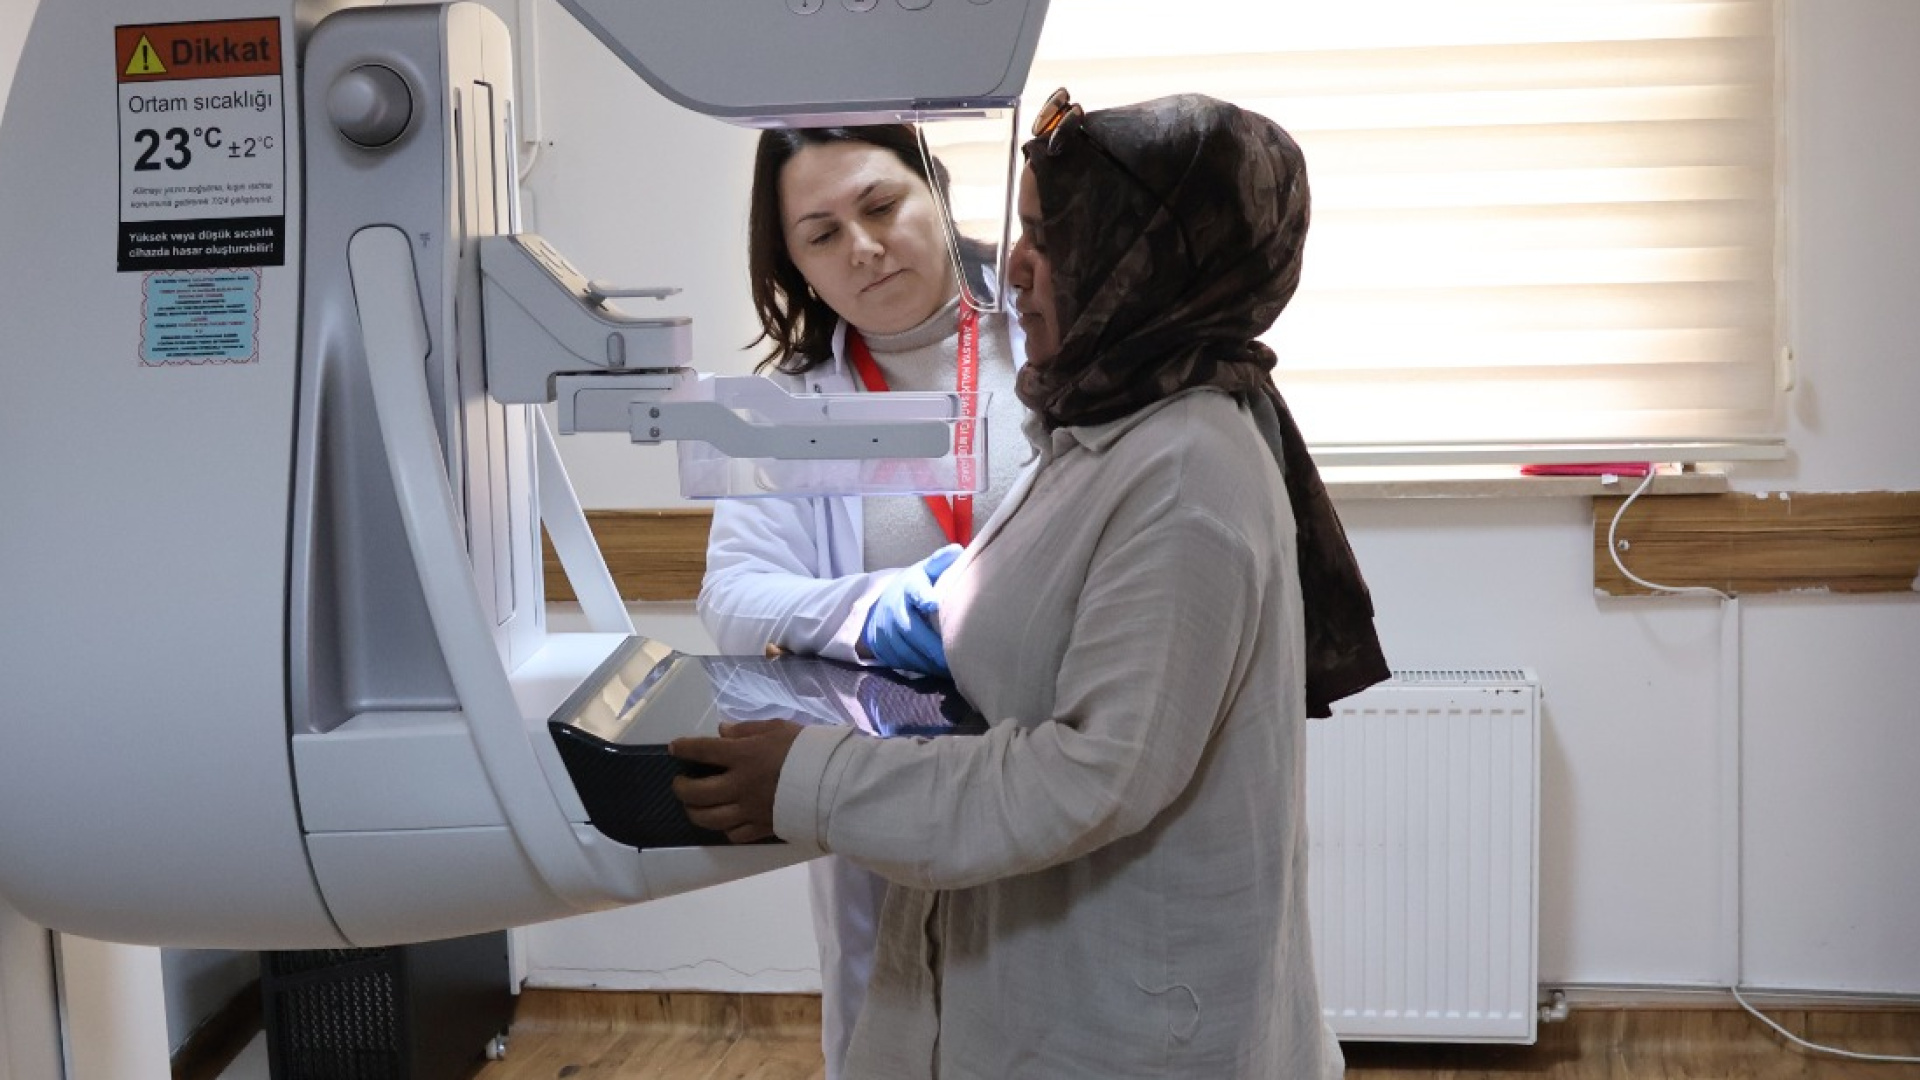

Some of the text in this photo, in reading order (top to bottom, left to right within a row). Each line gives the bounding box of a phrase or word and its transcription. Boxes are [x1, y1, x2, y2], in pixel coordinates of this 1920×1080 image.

[171, 36, 271, 65] Dikkat
[128, 90, 272, 113] Ortam sıcaklığı
[129, 227, 274, 243] Yüksek veya düşük sıcaklık
[128, 243, 274, 257] cihazda hasar oluşturabilir!
[962, 325, 973, 365] AMASYA
